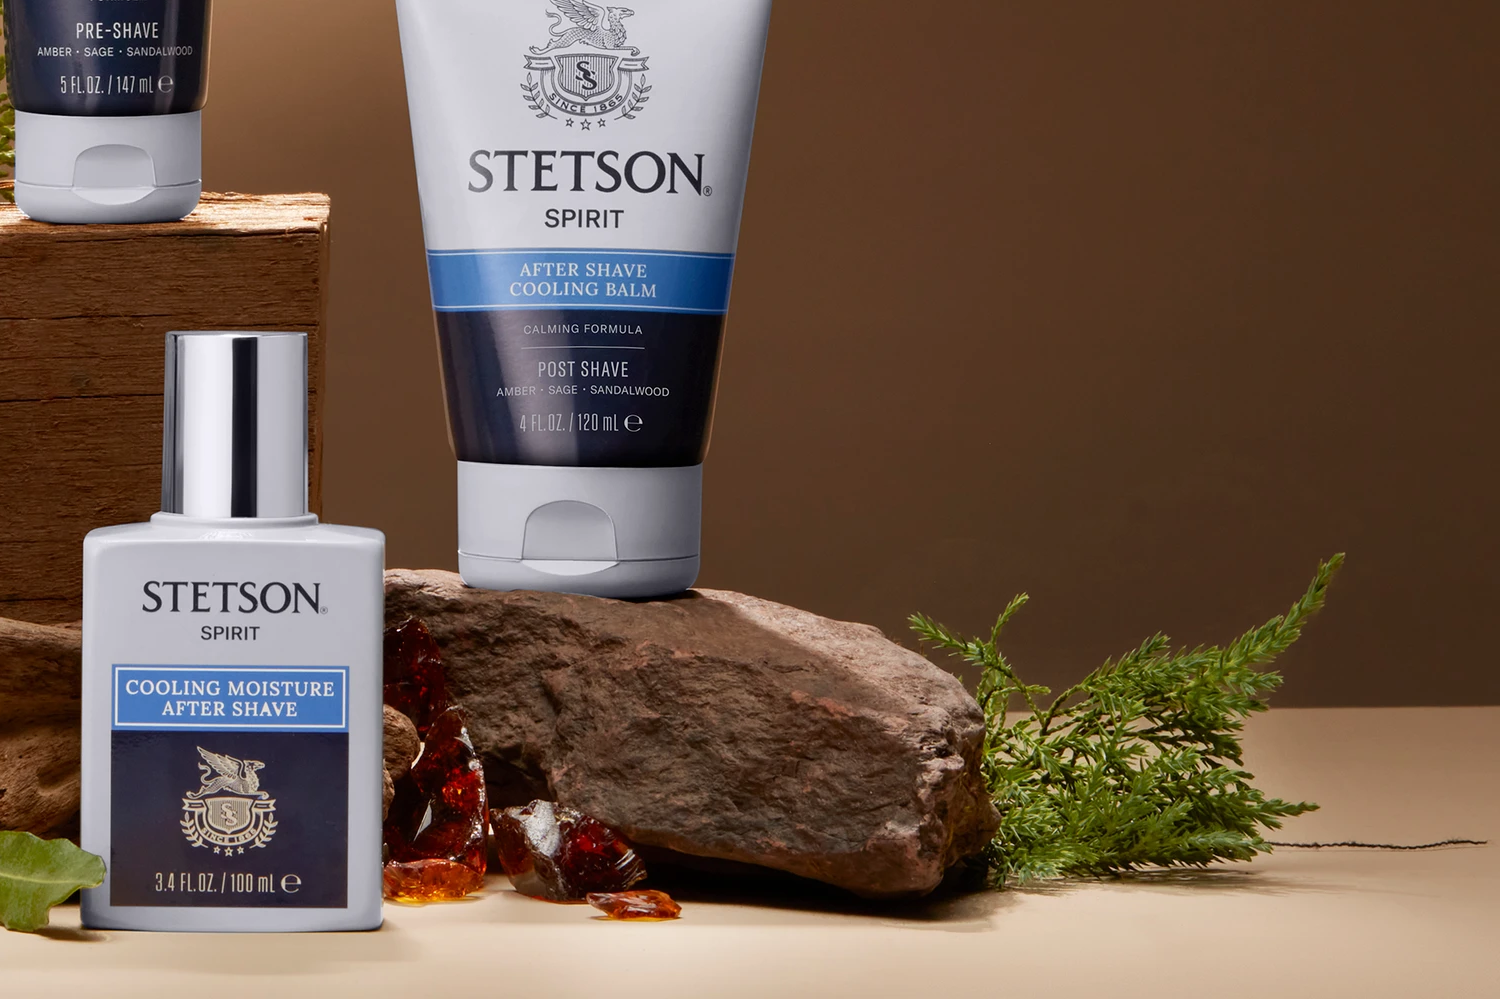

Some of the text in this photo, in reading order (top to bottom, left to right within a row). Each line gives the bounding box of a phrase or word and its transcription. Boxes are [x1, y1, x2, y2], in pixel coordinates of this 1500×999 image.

[76, 22, 159, 39] PRE-SHAVE
[37, 47, 193, 57] AMBER SAGE SANDALWOOD
[60, 76, 66, 93] 5
[116, 76, 136, 93] 147
[548, 92, 624, 114] SINCE 1865
[544, 208, 624, 229] SPIRIT
[520, 263, 648, 278] AFTER SHAVE
[510, 282, 657, 298] COOLING BALM
[523, 324, 643, 335] CALMING FORMULA
[538, 361, 629, 378] POST SHAVE
[496, 385, 670, 397] AMBER SAGE SANDALWOOD
[520, 414, 526, 432] 4
[578, 414, 598, 432] 120
[200, 625, 260, 641] SPIRIT
[125, 680, 335, 697] COOLING MOISTURE
[162, 701, 298, 717] AFTER SHAVE
[155, 873, 175, 891] 3.4
[230, 874, 253, 892] 100
